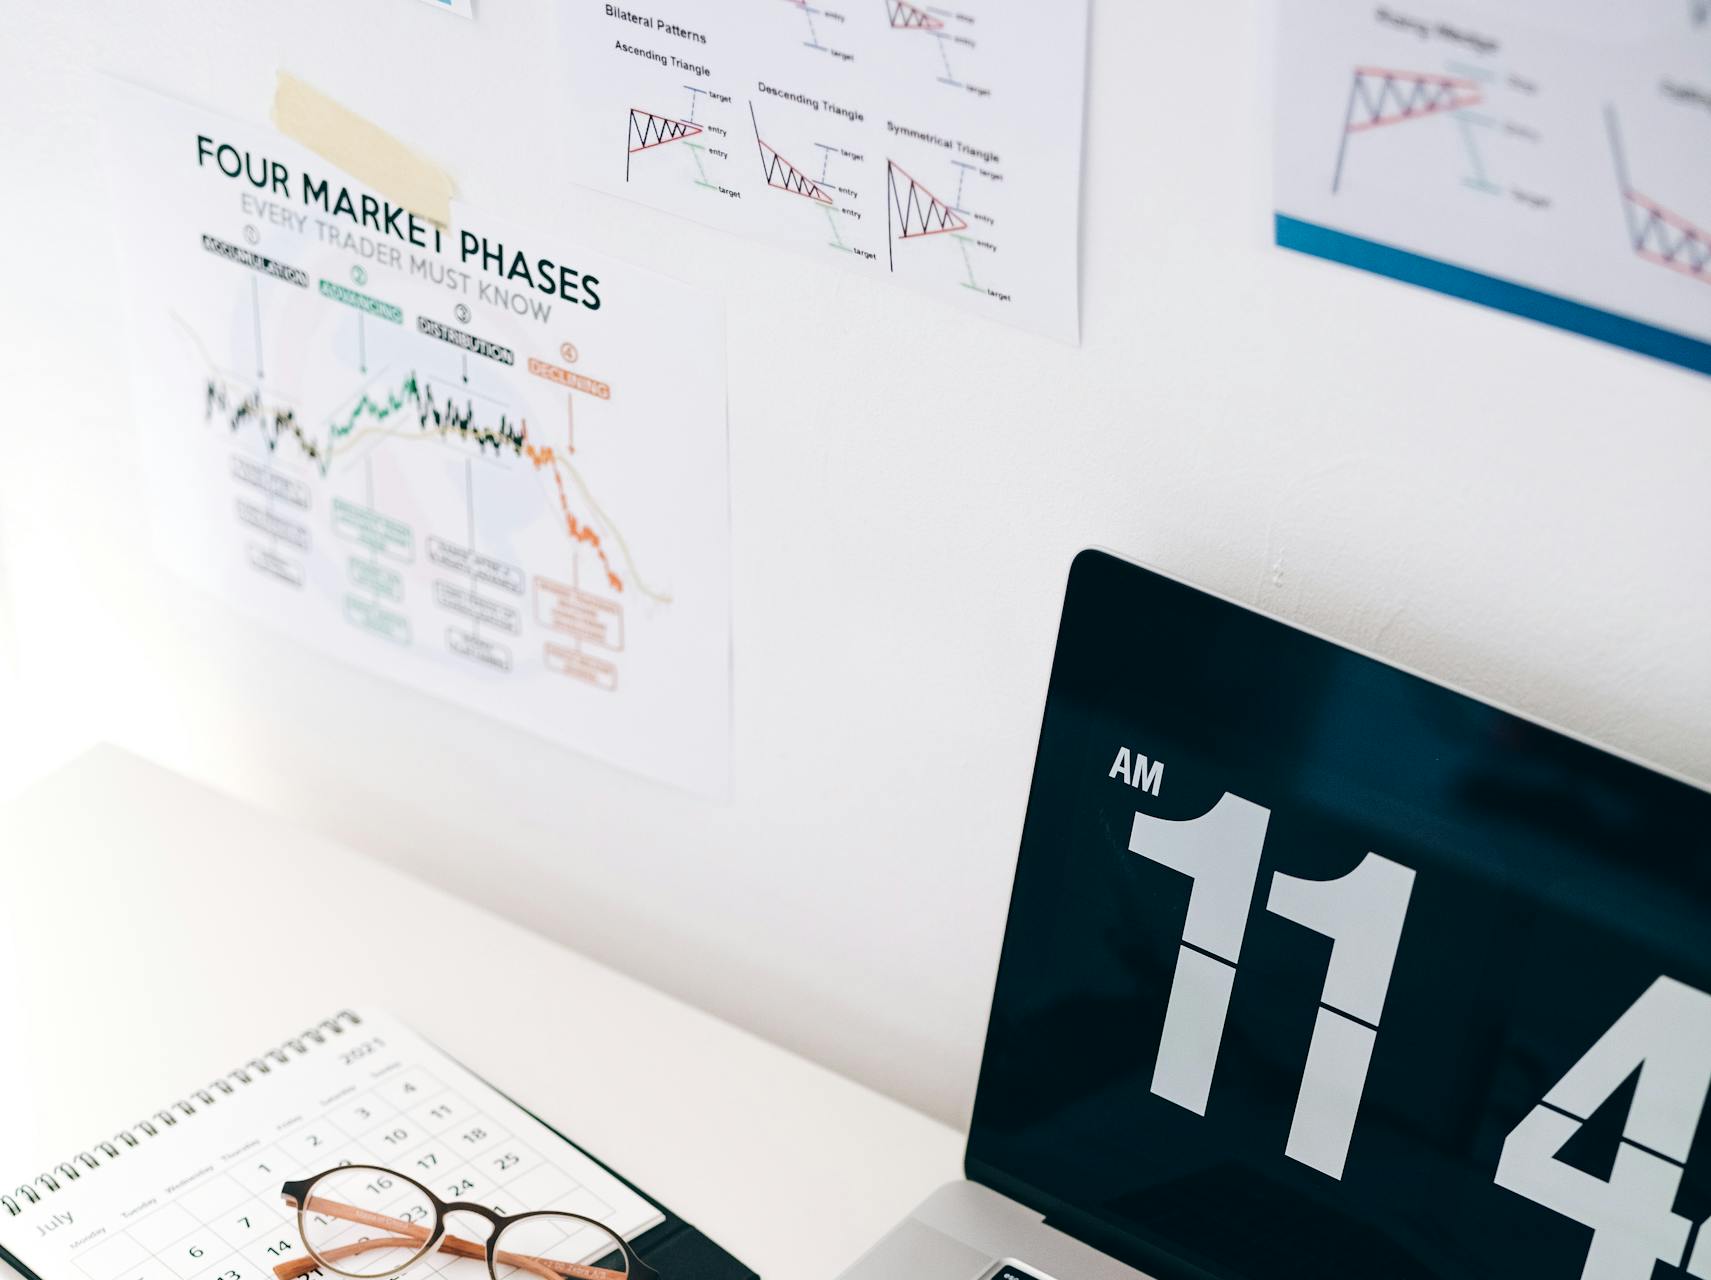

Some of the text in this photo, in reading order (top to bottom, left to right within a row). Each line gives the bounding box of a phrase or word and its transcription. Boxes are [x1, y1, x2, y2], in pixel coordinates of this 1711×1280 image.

[605, 4, 707, 44] Bilateral Patterns
[615, 40, 711, 77] Ascending Triangle
[709, 91, 732, 104] target
[758, 82, 864, 122] Descending Triangle
[708, 124, 727, 137] entry
[887, 121, 1000, 163] Symmetrical Triangle
[709, 148, 728, 159] entry
[841, 148, 864, 161] target
[718, 186, 741, 199] target
[839, 186, 858, 198] entry
[197, 134, 601, 310] FOUR MARKET PHASES
[842, 207, 861, 219] entry
[241, 192, 552, 324] EVERY TRADER MUST KNOW
[854, 247, 876, 260] target
[987, 288, 1011, 301] target
[418, 316, 514, 366] DISTRIBUTION
[1109, 746, 1164, 797] AM
[1127, 791, 1417, 1181] 11
[340, 1037, 386, 1066] 2021
[258, 1081, 417, 1174] 1 2 3 4
[189, 1246, 204, 1259] 6
[236, 1216, 252, 1229] 7
[384, 1128, 408, 1145] 10
[430, 1105, 453, 1119] 11
[267, 1240, 292, 1257] 14
[366, 1177, 393, 1195] 16
[417, 1153, 440, 1170] 17
[462, 1128, 487, 1145] 18
[400, 1205, 428, 1224] 23
[447, 1179, 475, 1197] 24
[493, 1152, 520, 1170] 25
[35, 1209, 75, 1238] July
[69, 1226, 107, 1249] Monday
